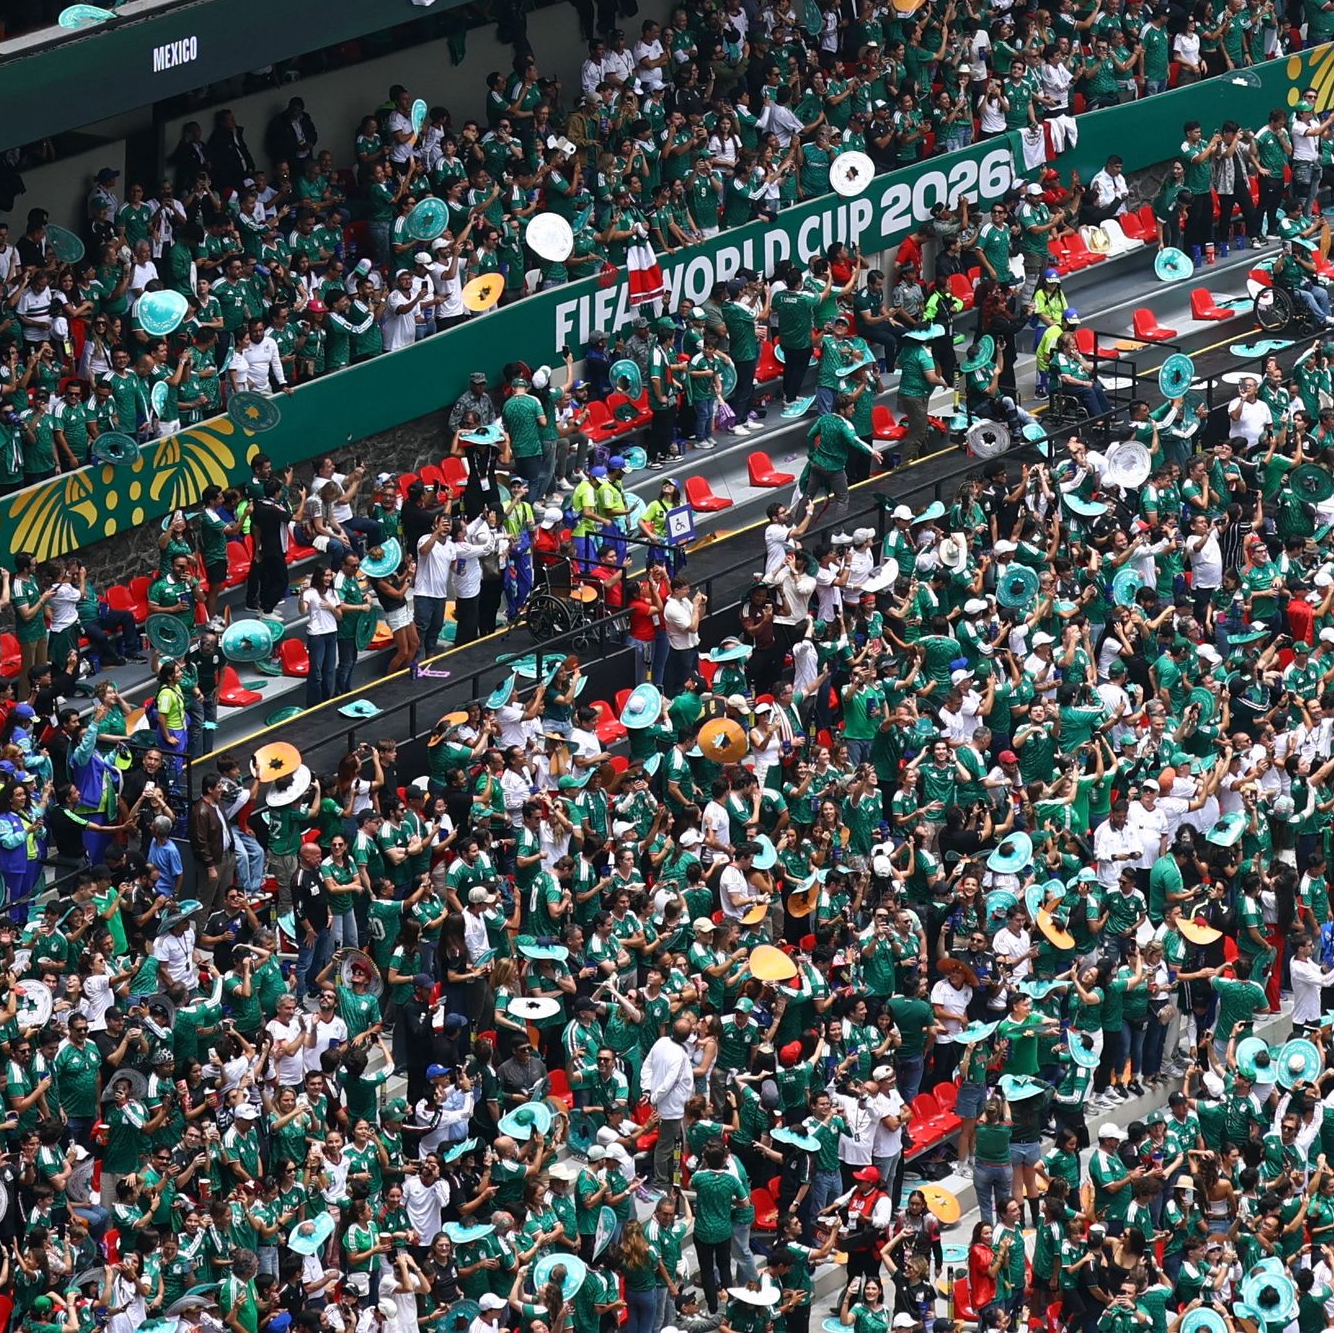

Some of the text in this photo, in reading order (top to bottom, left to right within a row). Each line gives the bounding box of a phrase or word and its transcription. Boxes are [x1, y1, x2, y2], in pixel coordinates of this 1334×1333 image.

[153, 35, 198, 73] MEXICO
[797, 197, 873, 265] CUP
[880, 148, 1012, 237] 2026
